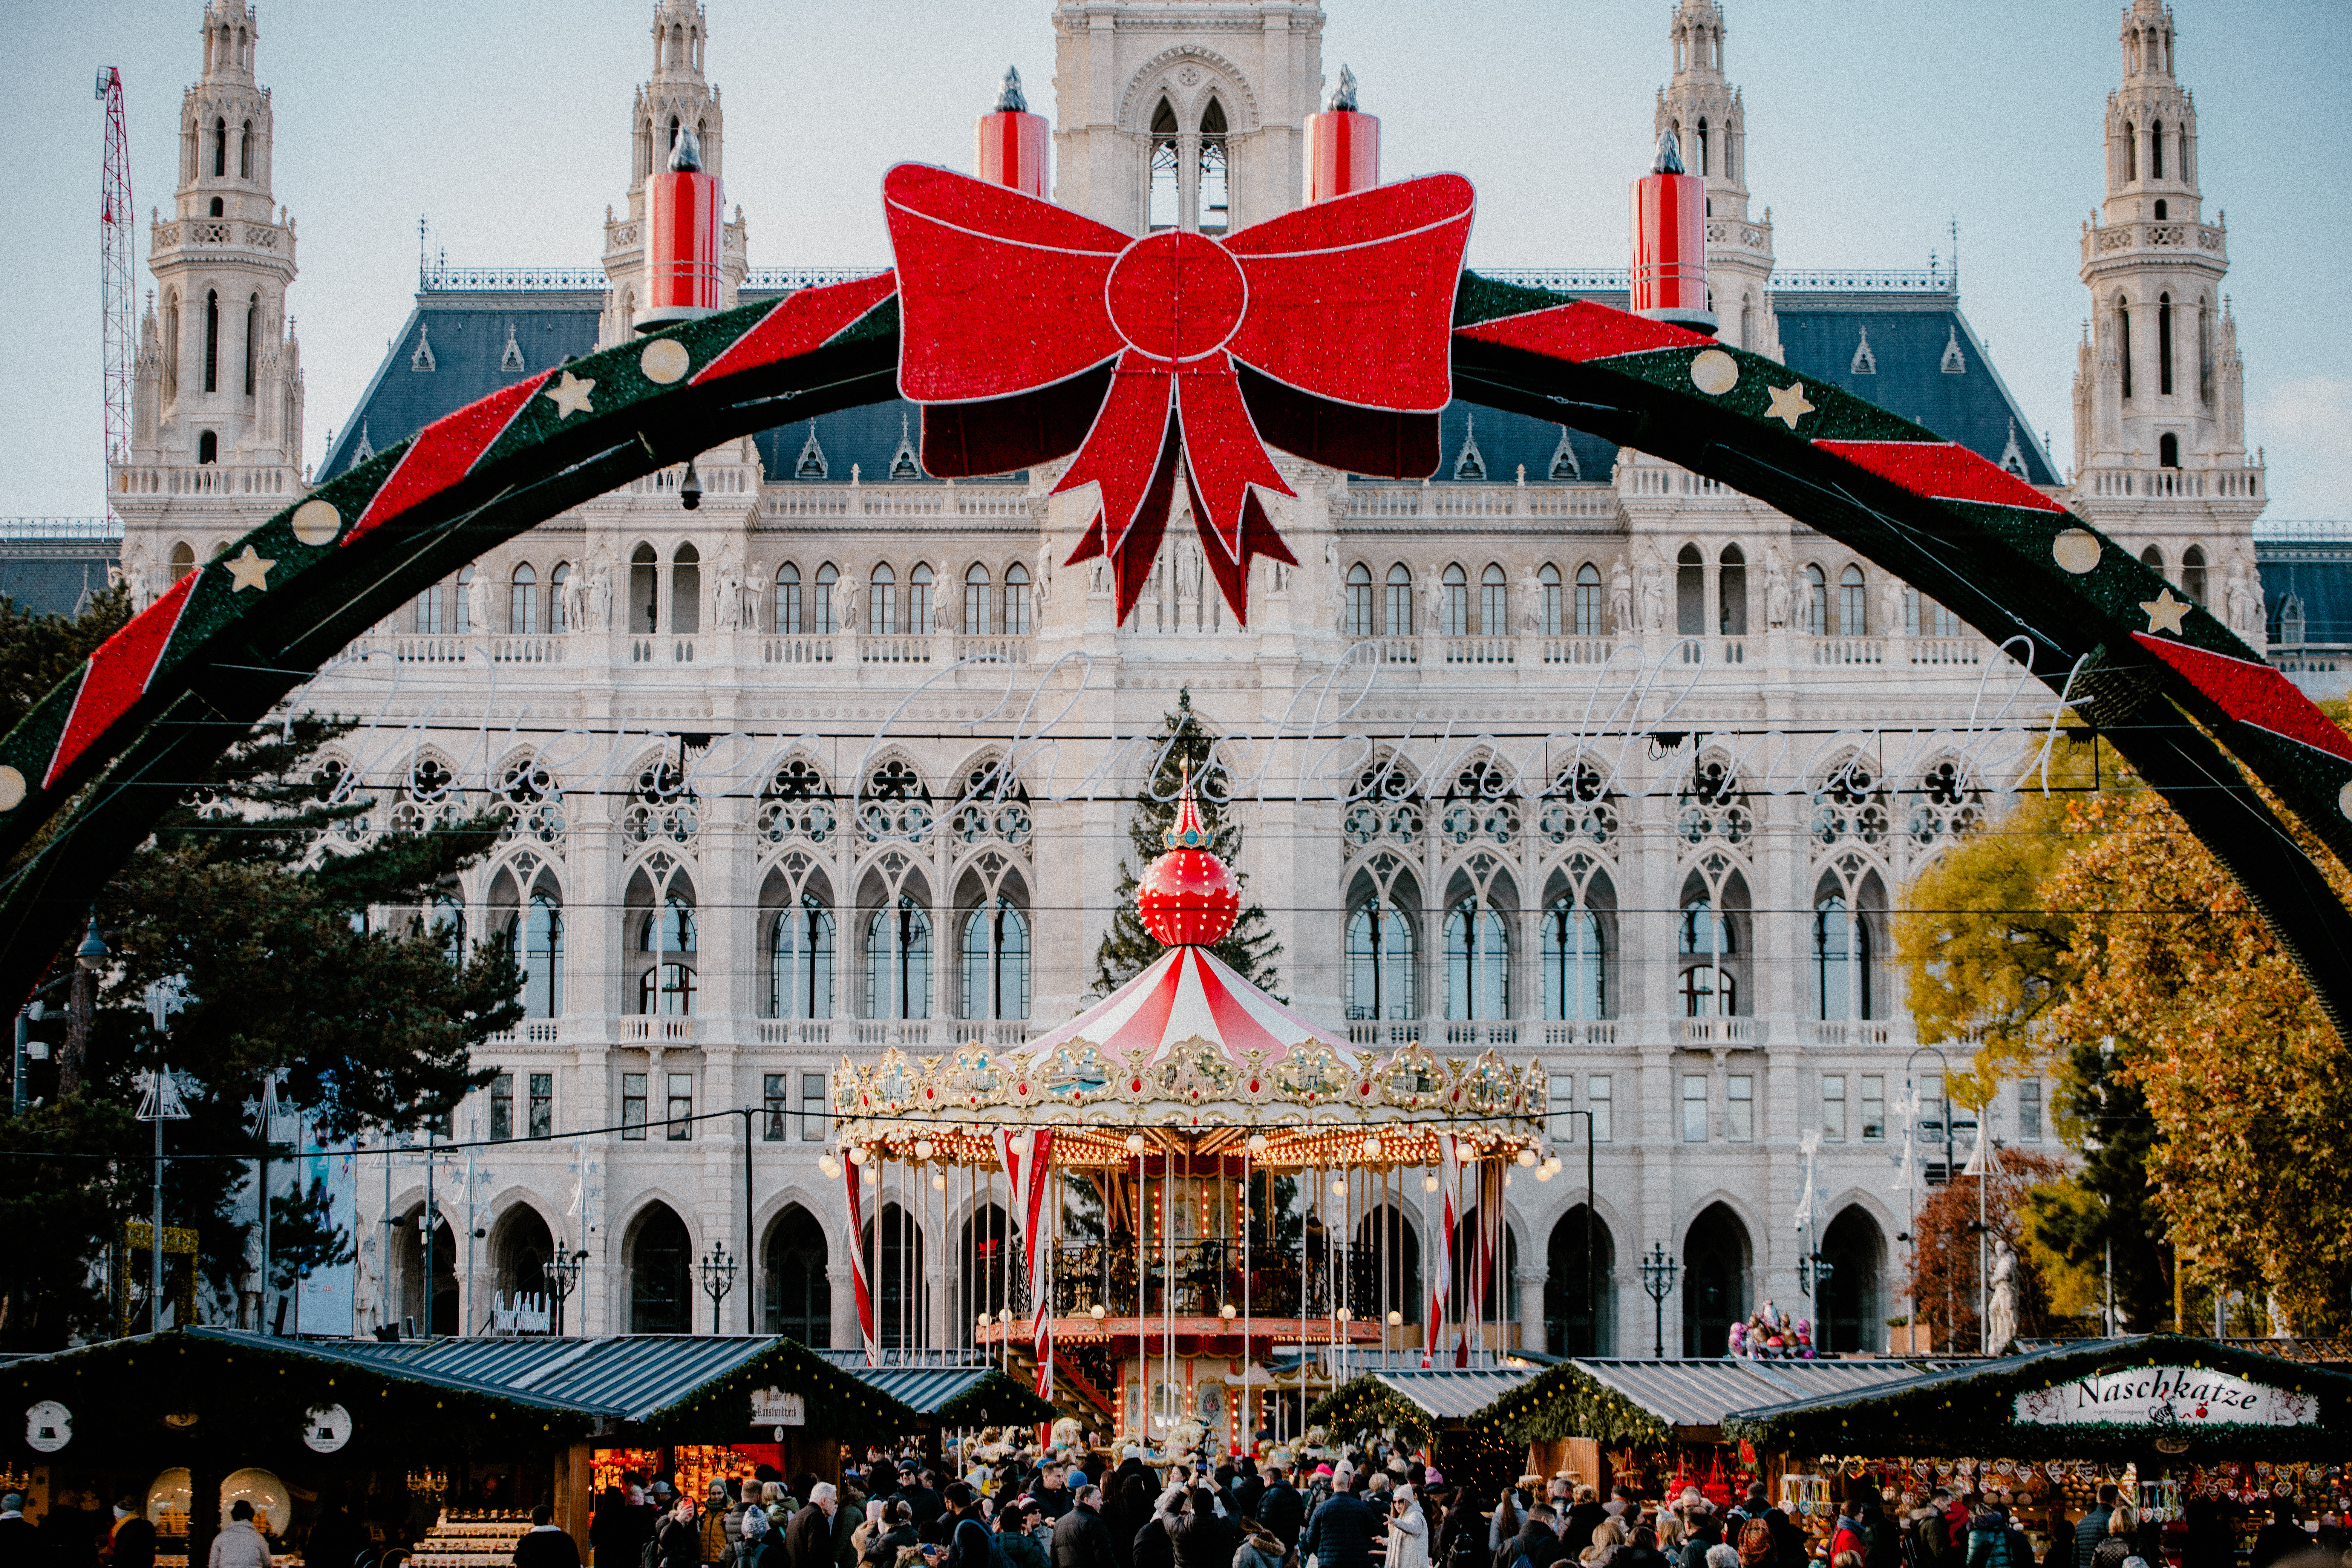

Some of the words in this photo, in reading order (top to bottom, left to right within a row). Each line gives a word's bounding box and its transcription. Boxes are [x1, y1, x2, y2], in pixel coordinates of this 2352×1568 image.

[283, 646, 822, 802] Wiener
[854, 635, 2095, 841] Christkindlmarkt
[2076, 1369, 2257, 1409] Naschkatze
[757, 1405, 796, 1418] Kunsthandwerk
[777, 1430, 782, 1438] 10
